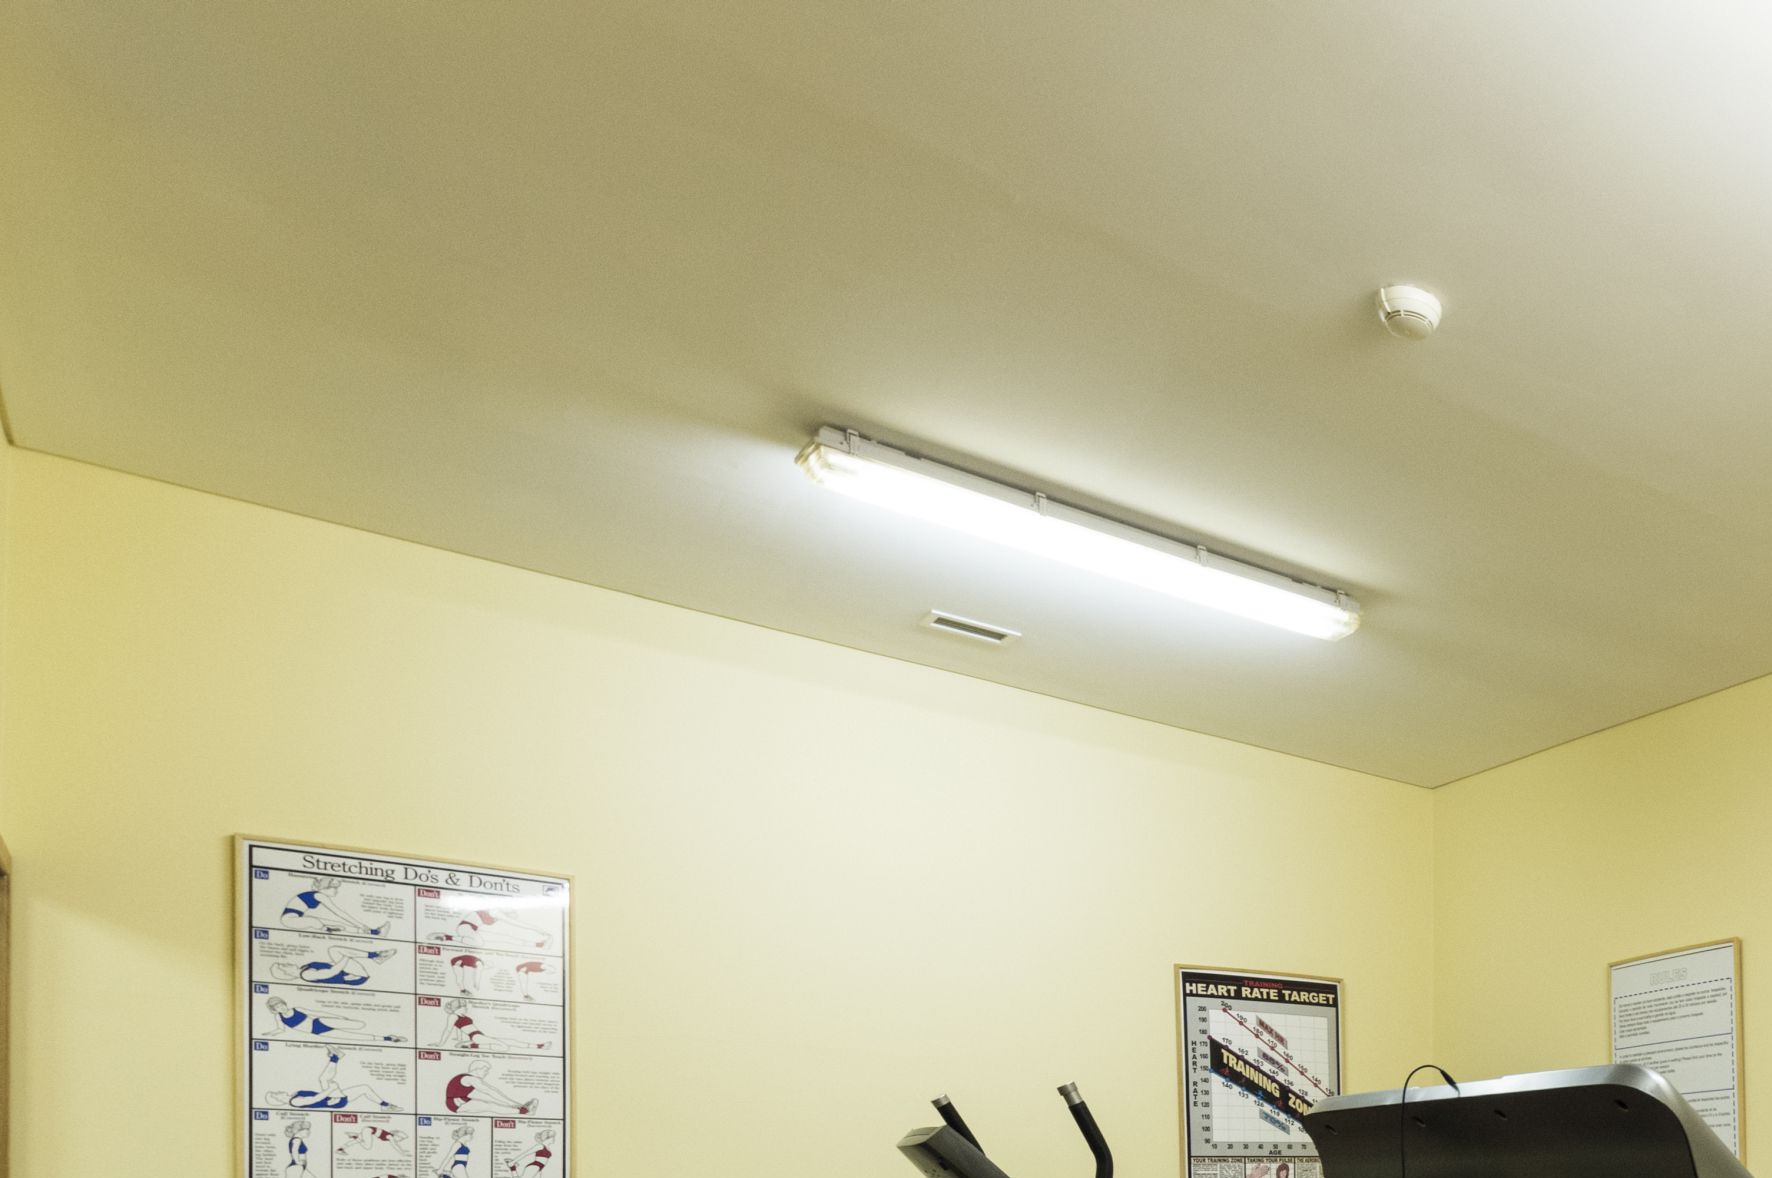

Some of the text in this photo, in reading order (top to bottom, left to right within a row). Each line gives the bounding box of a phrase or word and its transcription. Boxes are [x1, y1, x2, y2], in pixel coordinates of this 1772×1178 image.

[256, 870, 269, 879] Do
[302, 855, 395, 881] Stretching
[404, 866, 439, 884] Do's
[445, 872, 460, 887] &
[469, 874, 521, 894] Don'ts
[256, 930, 269, 939] Do
[420, 946, 440, 955] Don't
[1244, 980, 1283, 988] TRAINING
[256, 984, 268, 994] Do
[1186, 982, 1335, 1004] HEART RATE TARGET
[420, 998, 440, 1007] Don't
[256, 1042, 269, 1050] Do
[420, 1052, 440, 1060] Don't
[1221, 1049, 1313, 1116] TRAINING ZON
[256, 1112, 268, 1120] Do
[336, 1114, 357, 1123] Don't
[420, 1117, 431, 1126] Do
[496, 1120, 515, 1128] Don't
